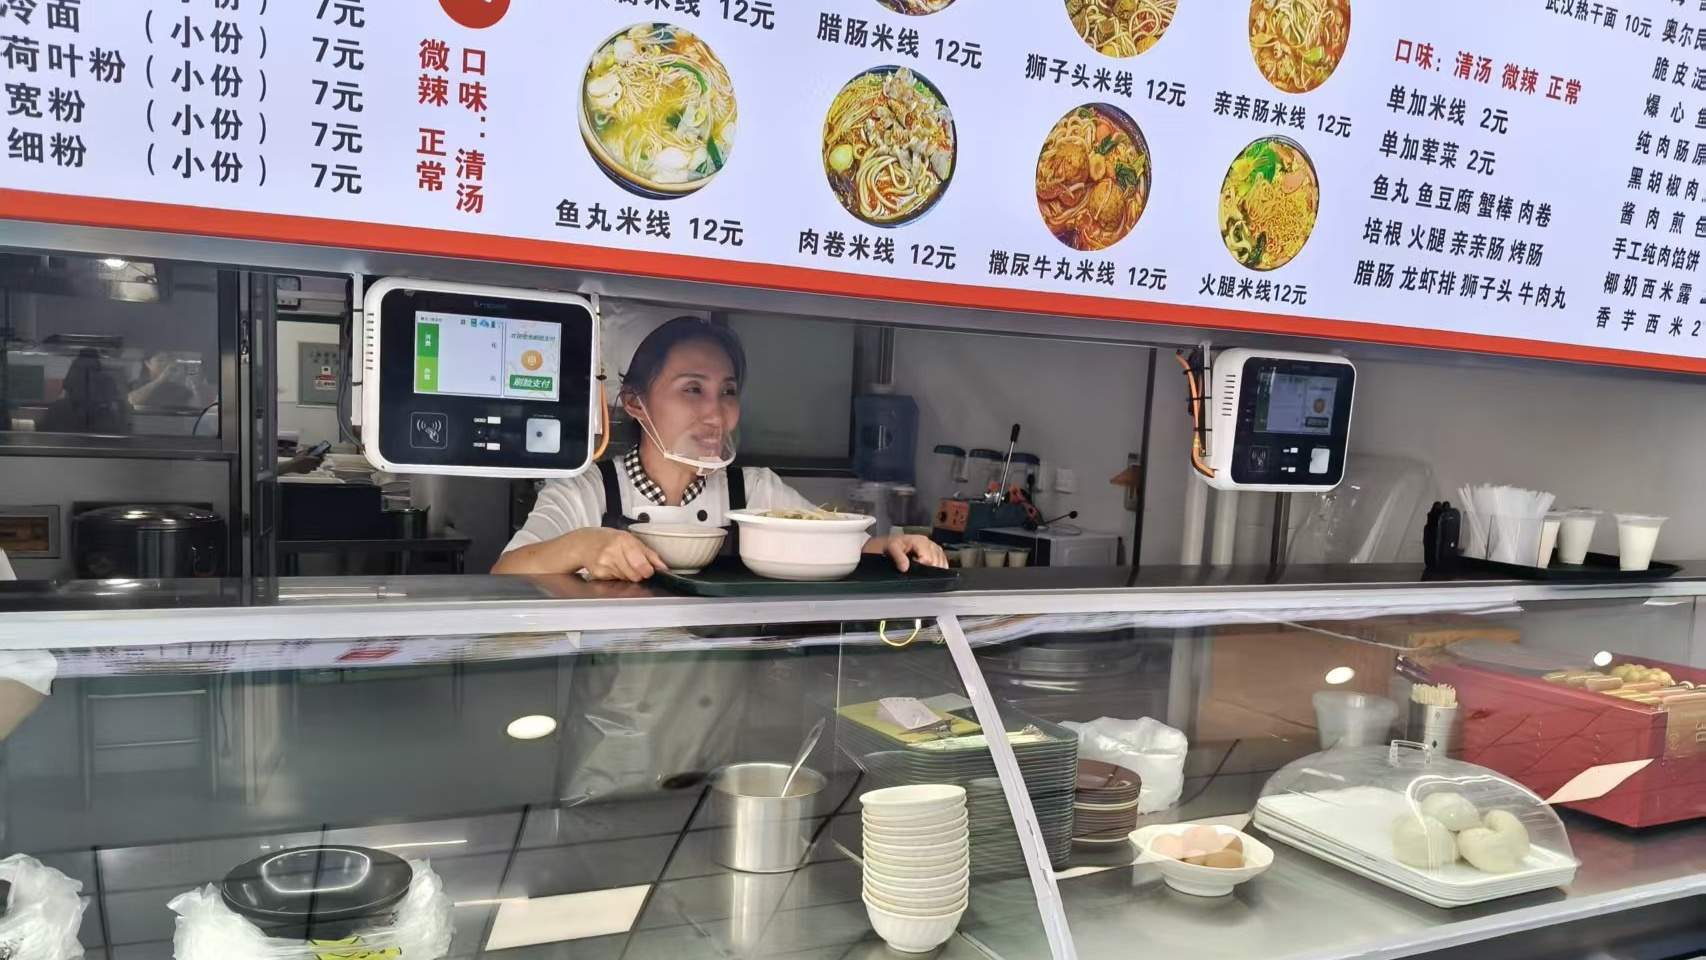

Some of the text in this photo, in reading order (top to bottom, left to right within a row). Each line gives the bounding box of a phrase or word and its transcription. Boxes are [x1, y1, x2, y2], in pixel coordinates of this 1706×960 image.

[315, 0, 366, 29] 7元
[719, 0, 775, 31] 12元
[1544, 0, 1653, 39] 武汉热干面 10元
[312, 36, 365, 71] 7元
[816, 12, 983, 70] 腊肠米线 12元
[0, 35, 126, 84] 荷叶粉
[311, 79, 364, 113] 7元
[1025, 53, 1187, 108] 狮子头米线 12元
[1453, 50, 1493, 85] 清汤
[1501, 62, 1540, 96] 微辣
[1545, 75, 1582, 105] 正常
[4, 82, 86, 124] 宽粉
[311, 121, 364, 154] 7元
[416, 38, 451, 192] 微辣 正常
[1213, 91, 1352, 139] 亲亲肠米线 12元
[1386, 83, 1509, 135] 单加米线 2元
[7, 126, 87, 168] 细粉
[310, 162, 363, 195] 7元
[1378, 129, 1496, 176] 单加荤菜 2元
[1369, 173, 1552, 228] 鱼丸 鱼豆腐 蟹棒 肉卷
[1627, 166, 1706, 203] 黑胡椒肉
[554, 199, 744, 247] 鱼丸米线 12元
[1362, 216, 1545, 268] 培根 火腿 亲亲肠 烤肠
[1620, 201, 1706, 239] 酱肉煎包
[798, 228, 957, 271] 肉卷米线 12元
[988, 249, 1168, 291] 撒尿牛丸米线 12元
[1612, 237, 1701, 272] 手工纯肉馅饼
[1352, 259, 1567, 310] 腊肠 龙虾排 狮子头 牛肉丸
[1603, 271, 1693, 305] 椰奶西米露
